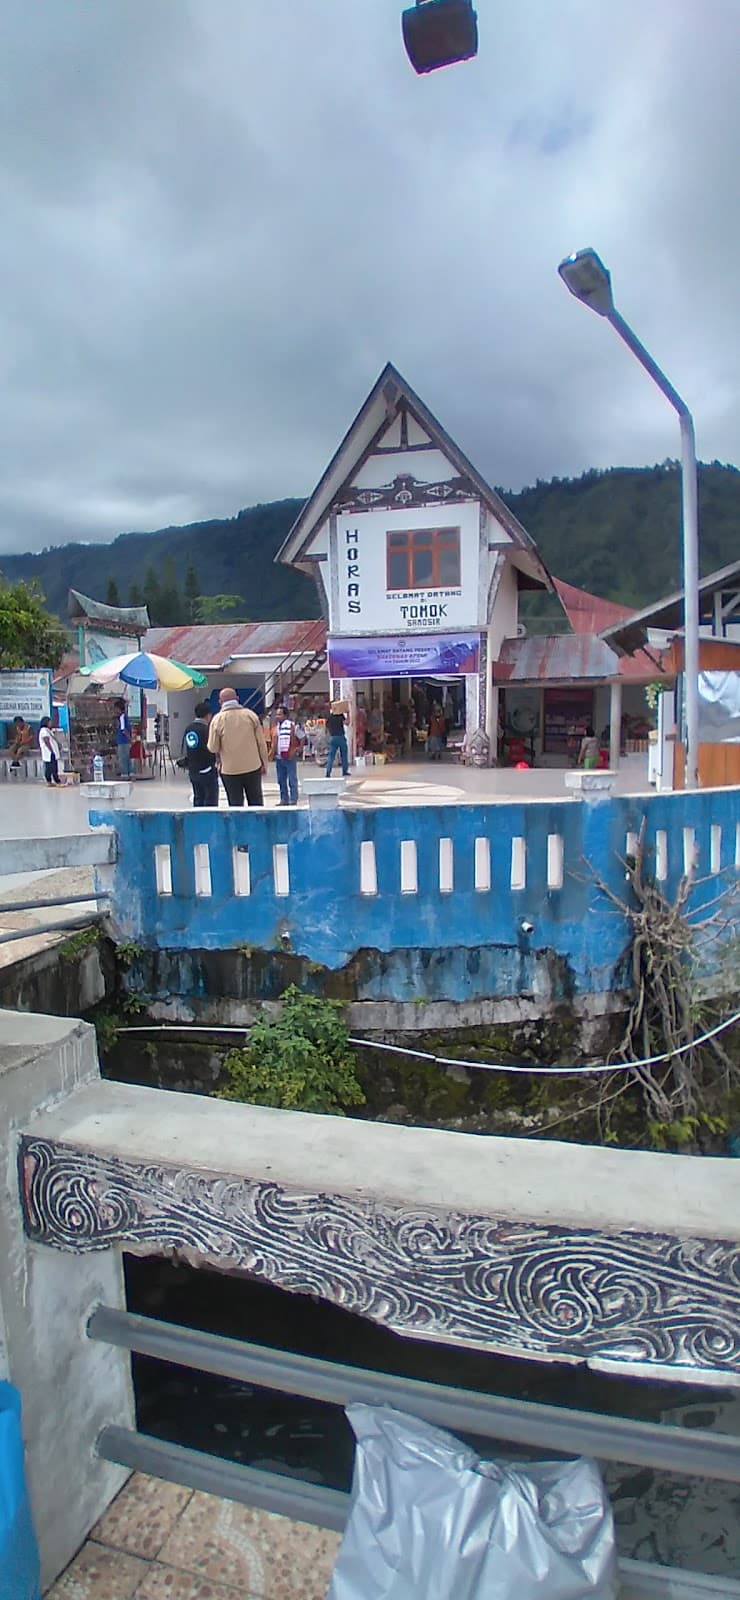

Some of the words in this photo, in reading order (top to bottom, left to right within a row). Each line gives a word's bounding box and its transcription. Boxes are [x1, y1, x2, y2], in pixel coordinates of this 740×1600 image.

[345, 528, 361, 614] HORAS
[386, 592, 425, 600] SELAMAT
[427, 590, 462, 598] DATANG
[400, 604, 448, 619] TOMOK
[407, 618, 441, 627] SAMOSIR
